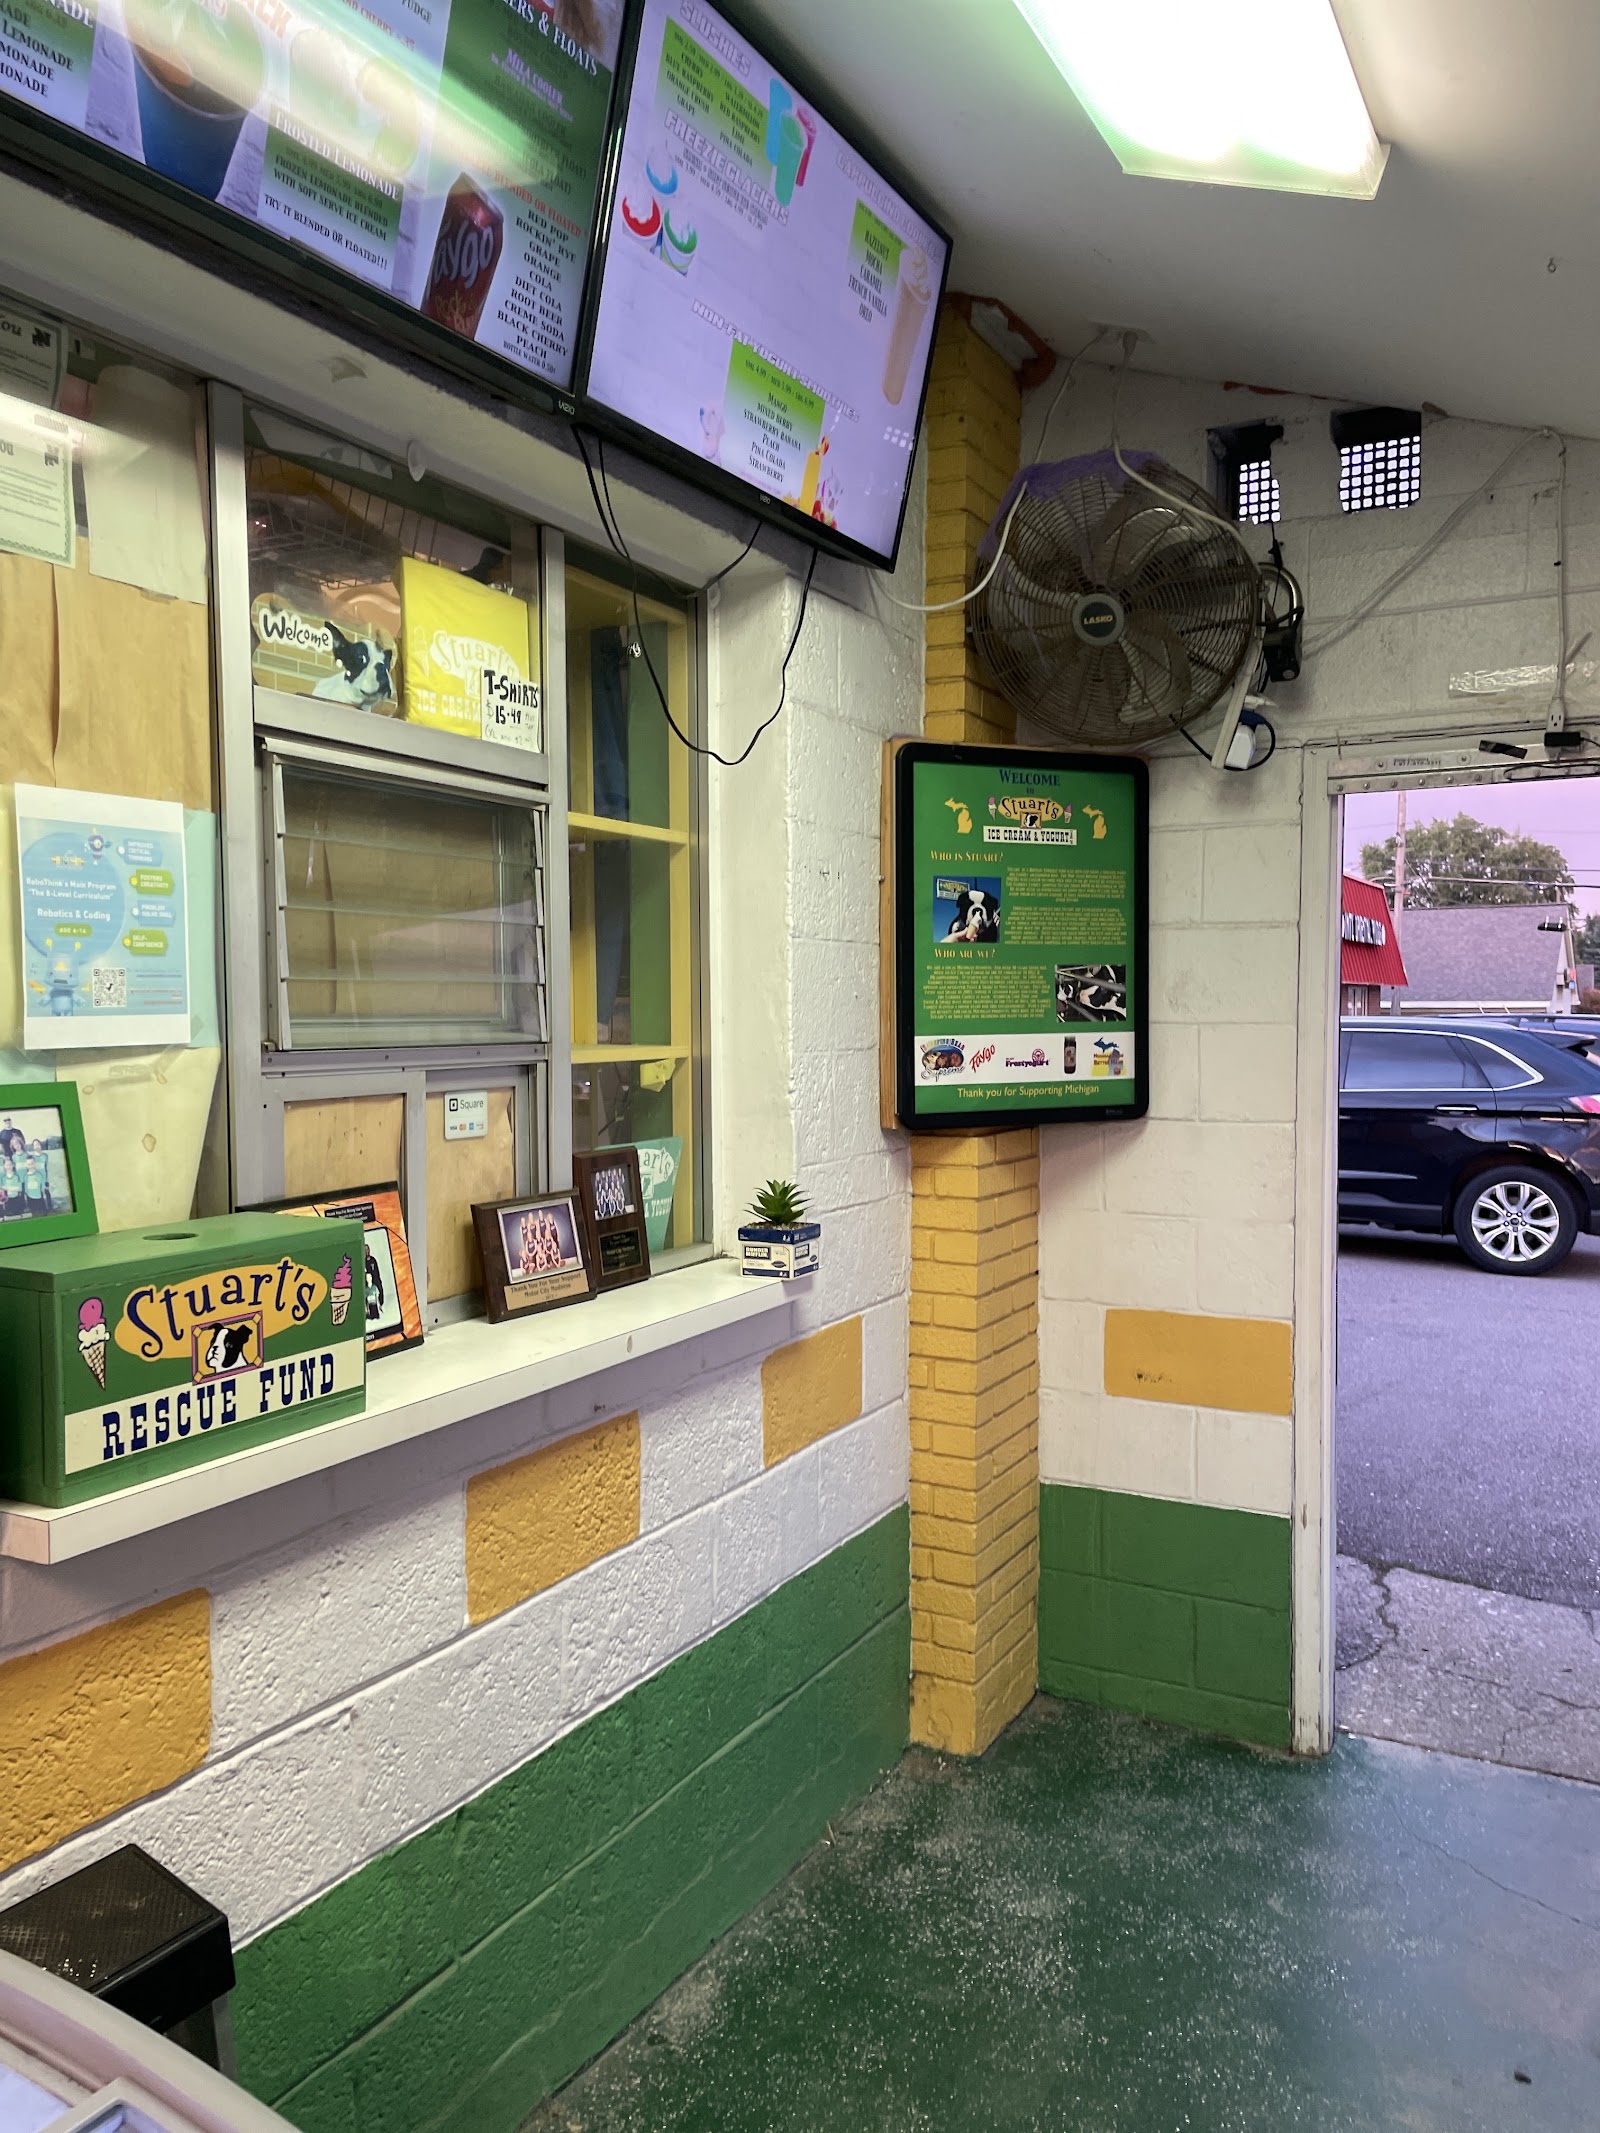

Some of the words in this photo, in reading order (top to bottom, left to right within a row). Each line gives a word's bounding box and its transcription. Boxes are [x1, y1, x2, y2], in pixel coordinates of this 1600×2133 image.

[3, 19, 73, 72] LEMONADE
[539, 12, 549, 36] &
[554, 26, 597, 76] FLOATS
[0, 62, 49, 98] ONADE
[275, 111, 330, 157] FROSTED
[334, 148, 399, 199] LEMONADE
[274, 167, 296, 189] WITH
[298, 182, 318, 201] SOFT
[319, 194, 344, 217] SERVE
[346, 209, 358, 225] ICE
[360, 217, 387, 241] CREAM
[275, 154, 308, 181] FROZEN
[310, 173, 352, 207] LEMONADE
[355, 199, 389, 227] BLENDED
[264, 193, 281, 211] TRY
[283, 204, 292, 216] IT
[293, 211, 330, 238] BLENDED
[332, 229, 344, 246] OR
[345, 238, 388, 271] FLOATED!!!
[516, 216, 556, 247] ROCKIN'
[528, 209, 547, 229] RED
[550, 225, 569, 243] POP
[426, 219, 494, 289] aygo
[524, 252, 561, 282] ORANGE
[529, 241, 560, 266] GRAPE
[515, 276, 537, 295] DIET
[540, 291, 562, 311] COLA
[529, 270, 552, 291] COLA
[860, 263, 882, 294] CARAMEL
[504, 300, 538, 324] CREME
[541, 321, 564, 341] SODA
[511, 288, 537, 309] ROOT
[540, 305, 562, 326] BEER
[497, 310, 529, 334] BLACK
[532, 330, 568, 356] CHERRY
[516, 335, 547, 359] PEACH
[743, 408, 779, 438] STRAWBERRY
[775, 415, 792, 432] BERRY
[749, 454, 783, 483] STRAWBERRY
[263, 614, 330, 647] Welcome
[1083, 614, 1113, 625] LASKO
[417, 688, 437, 714] ICE
[999, 769, 1061, 786] WELCOME
[1001, 798, 1059, 820] Stuart's
[988, 828, 1000, 841] ICE
[1003, 829, 1031, 842] CREAM
[1034, 831, 1039, 842] &
[931, 850, 952, 861] WHO
[954, 852, 963, 861] IS
[70, 880, 86, 889] Main
[87, 882, 117, 891] Program
[37, 908, 73, 918] Robotics
[75, 910, 81, 918] &
[83, 910, 111, 922] Coding
[934, 948, 956, 958] WHO
[958, 949, 973, 958] ARE
[968, 1044, 996, 1074] Faygo
[460, 1099, 484, 1110] Square
[957, 1087, 984, 1098] Thank
[986, 1089, 1002, 1100] you
[1004, 1087, 1016, 1096] for
[1019, 1086, 1063, 1097] Supporting
[1065, 1084, 1099, 1096] Michigan
[644, 1149, 671, 1180] art's
[511, 1285, 528, 1294] Thank
[561, 1272, 582, 1282] Support
[525, 1290, 539, 1298] Motor
[126, 1259, 317, 1358] Stuart's
[102, 1379, 237, 1460] RESCUE
[259, 1353, 335, 1413] FUND
